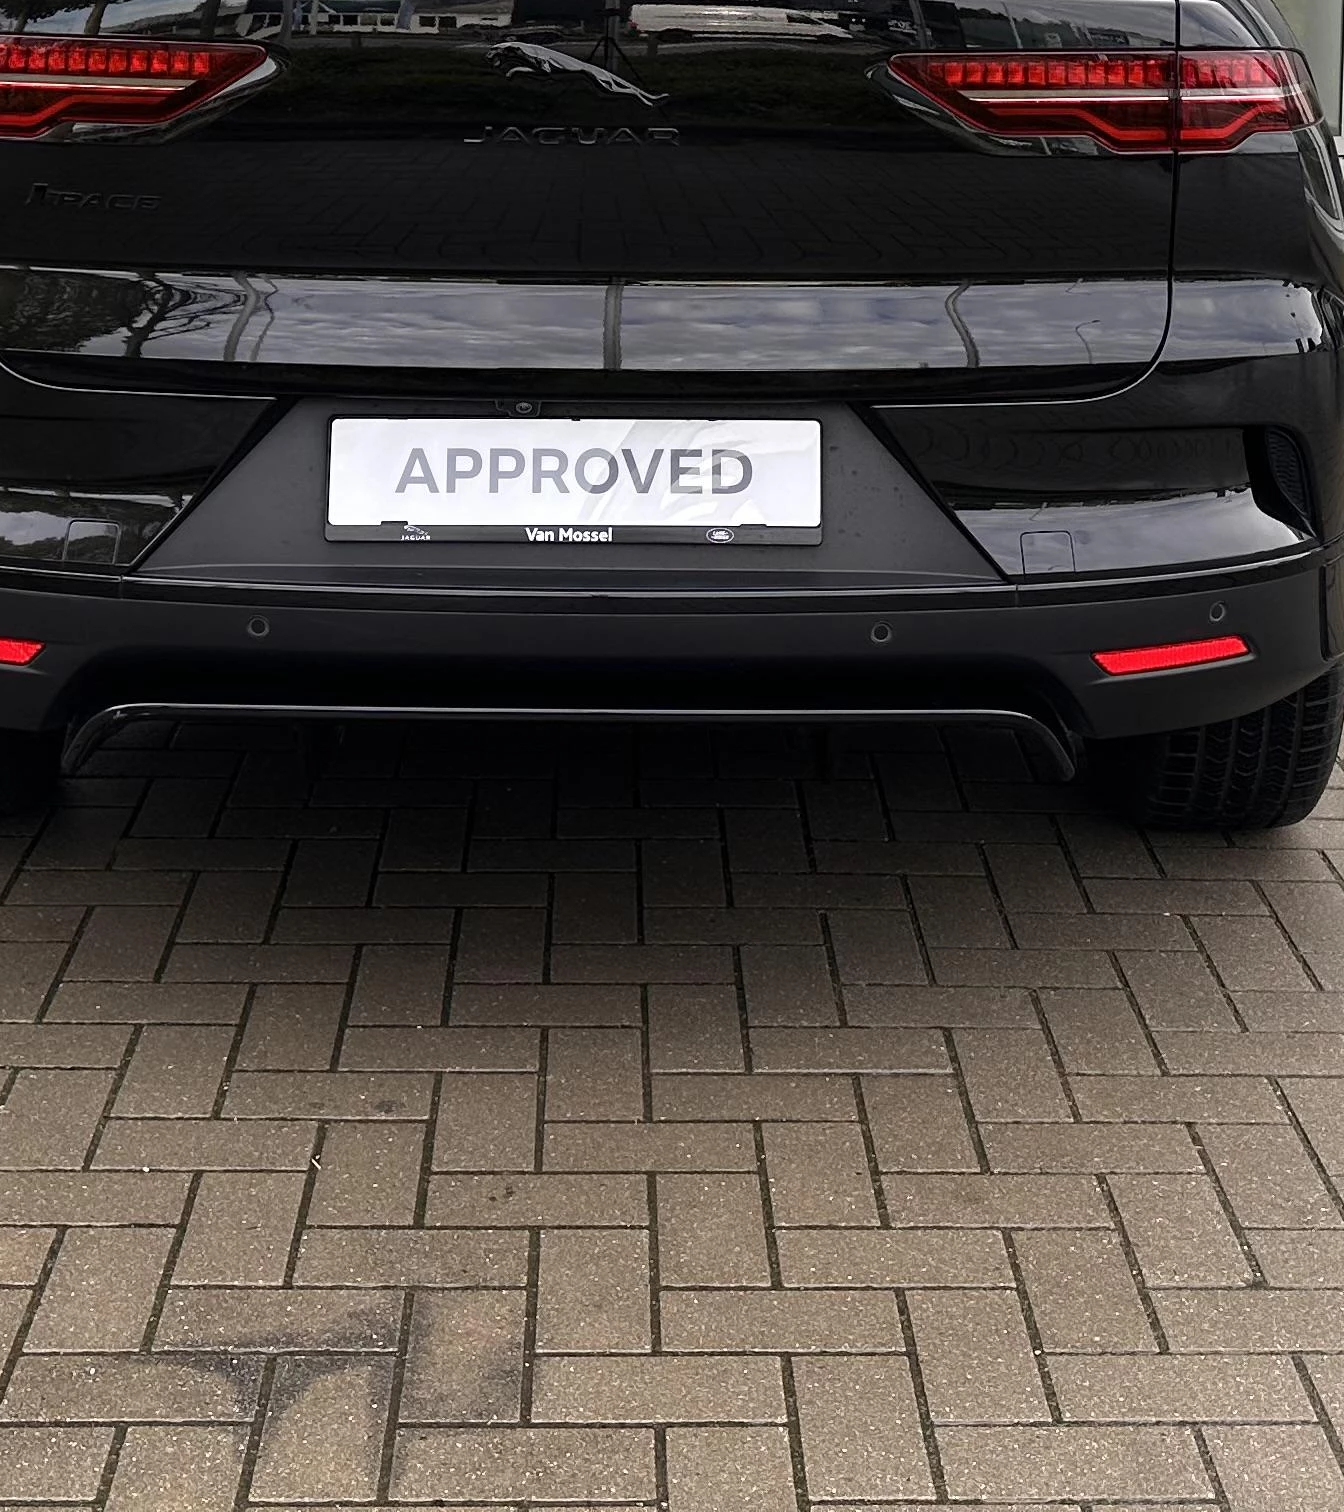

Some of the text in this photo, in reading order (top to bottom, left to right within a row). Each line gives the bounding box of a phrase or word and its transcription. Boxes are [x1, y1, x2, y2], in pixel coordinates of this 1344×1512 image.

[463, 126, 681, 146] JAGUAR
[395, 446, 754, 495] APPROVED
[525, 527, 555, 542] Van
[559, 527, 613, 543] Mossel
